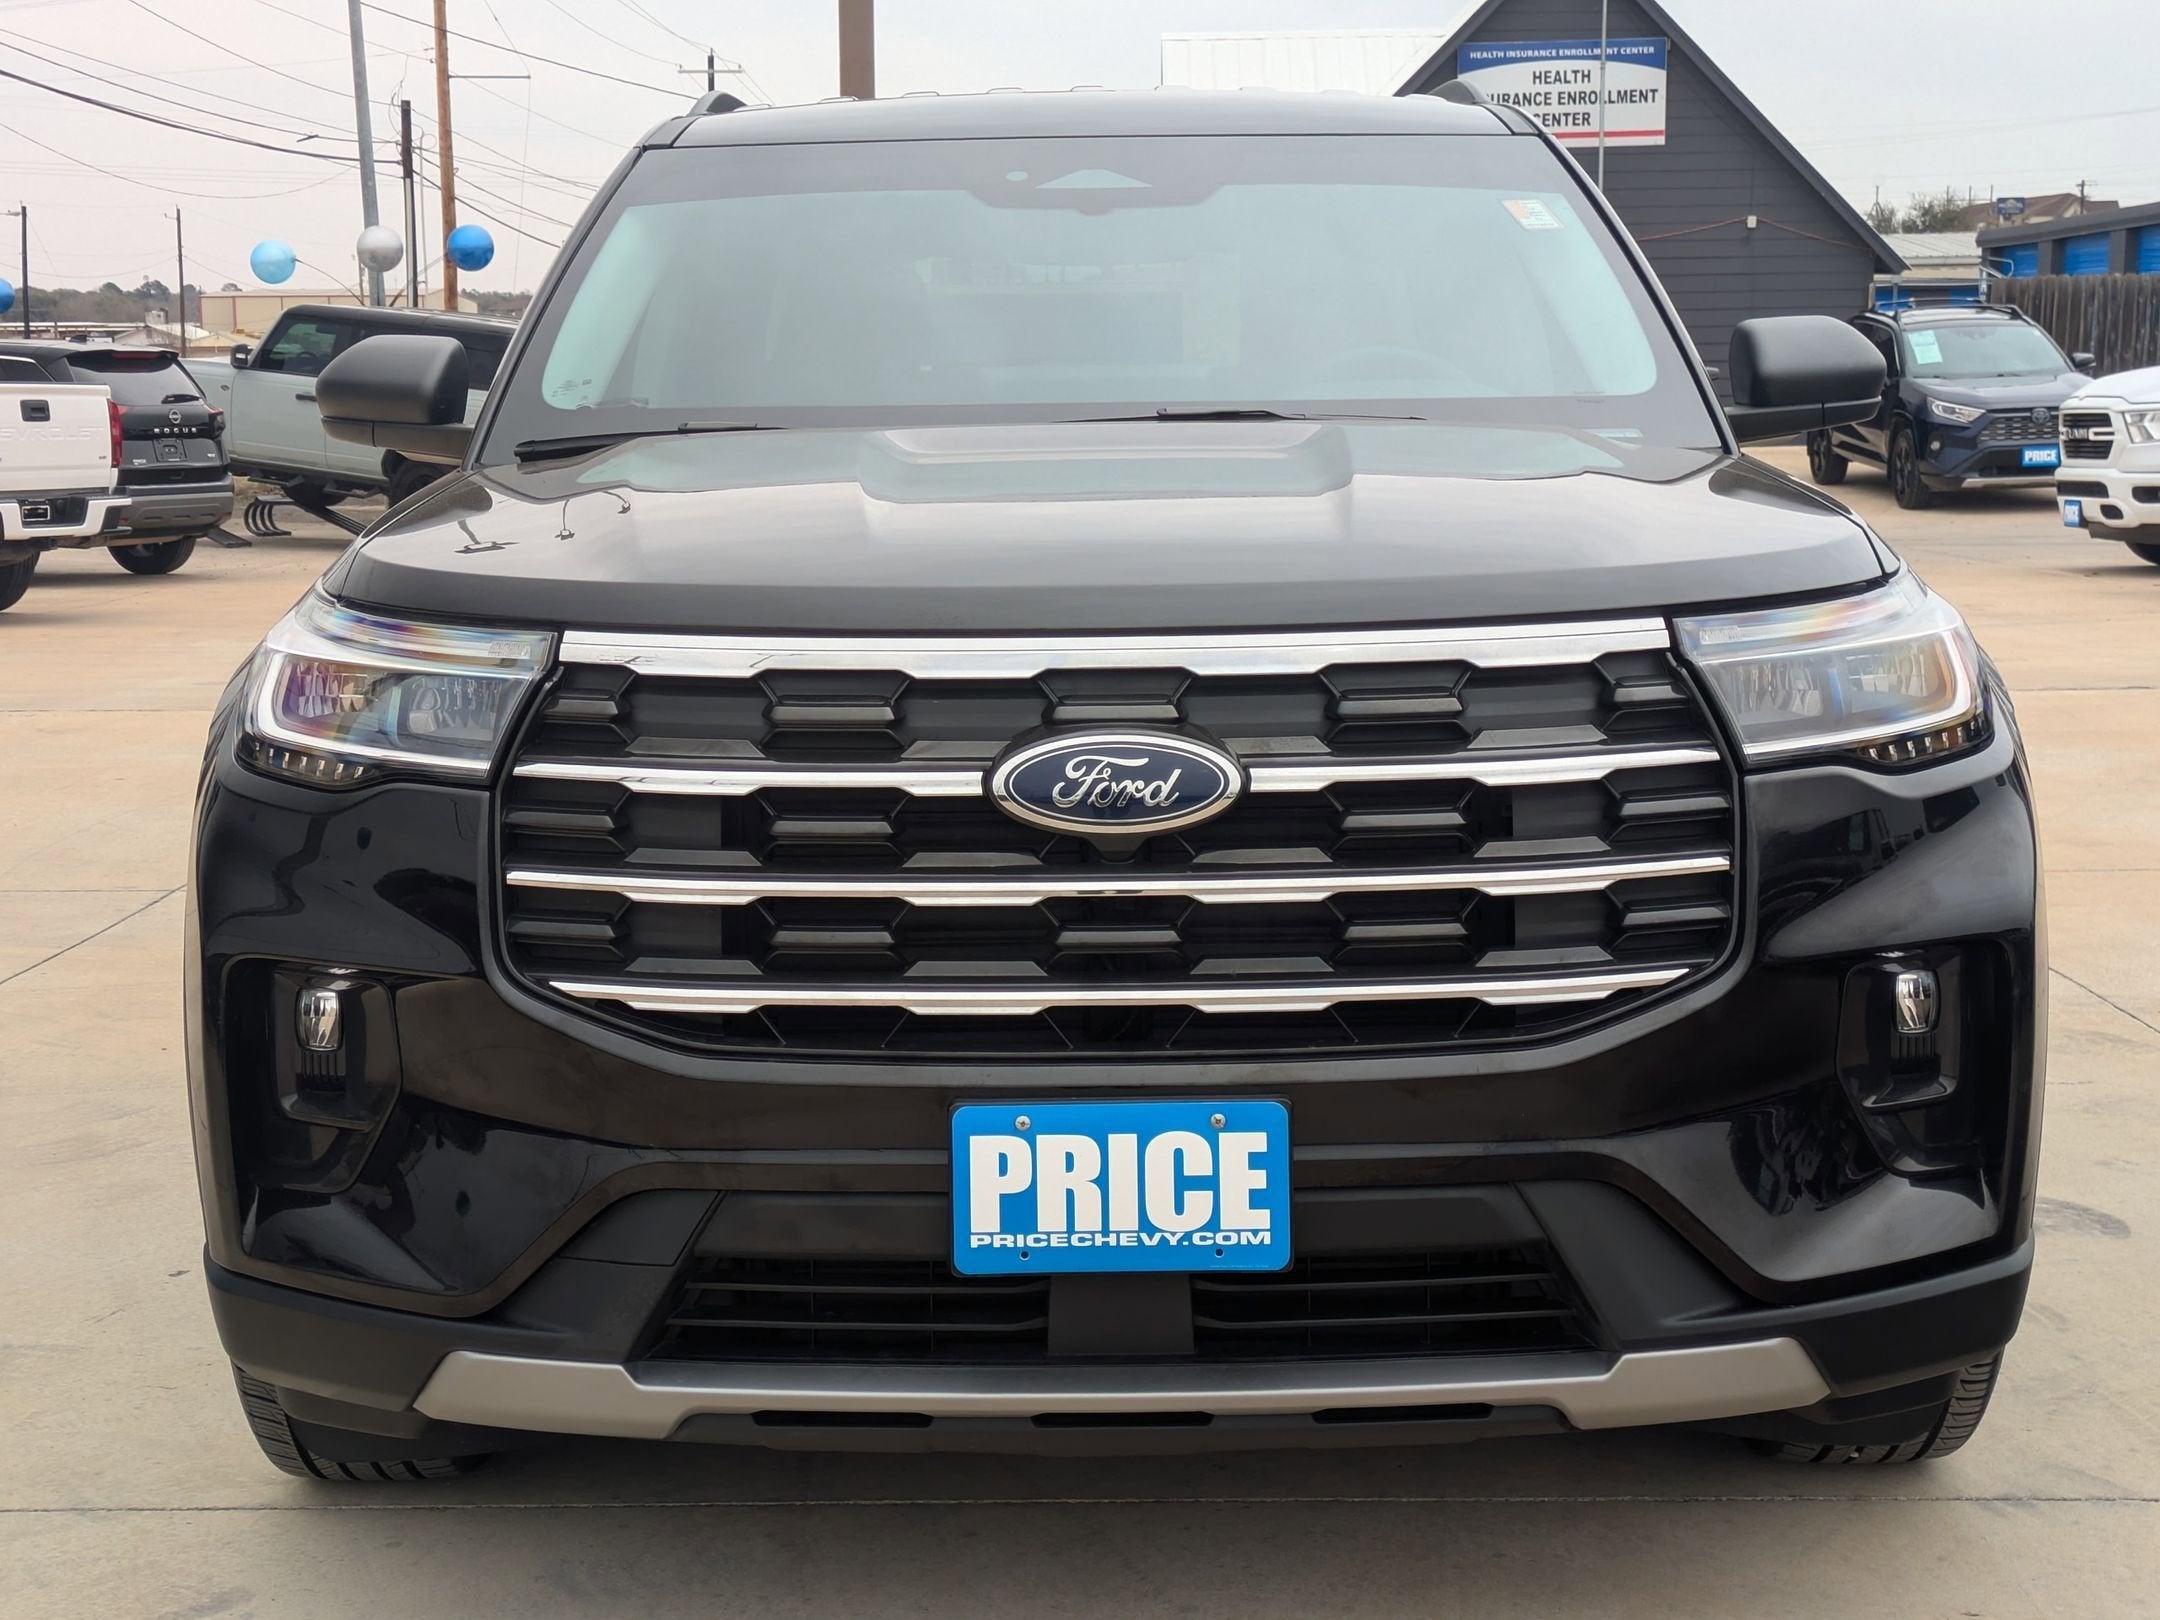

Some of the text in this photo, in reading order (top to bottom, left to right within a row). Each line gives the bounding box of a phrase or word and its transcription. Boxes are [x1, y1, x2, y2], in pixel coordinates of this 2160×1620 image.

[1470, 46, 1655, 59] HEALTH INSURANCE ENROLLMNT CENTER
[1533, 69, 1591, 85] HEALTH
[2025, 449, 2057, 462] PRICE
[1052, 755, 1182, 808] Ford
[969, 1131, 1271, 1233] PRICE
[970, 1231, 1271, 1249] PRICECHEVY.COM
